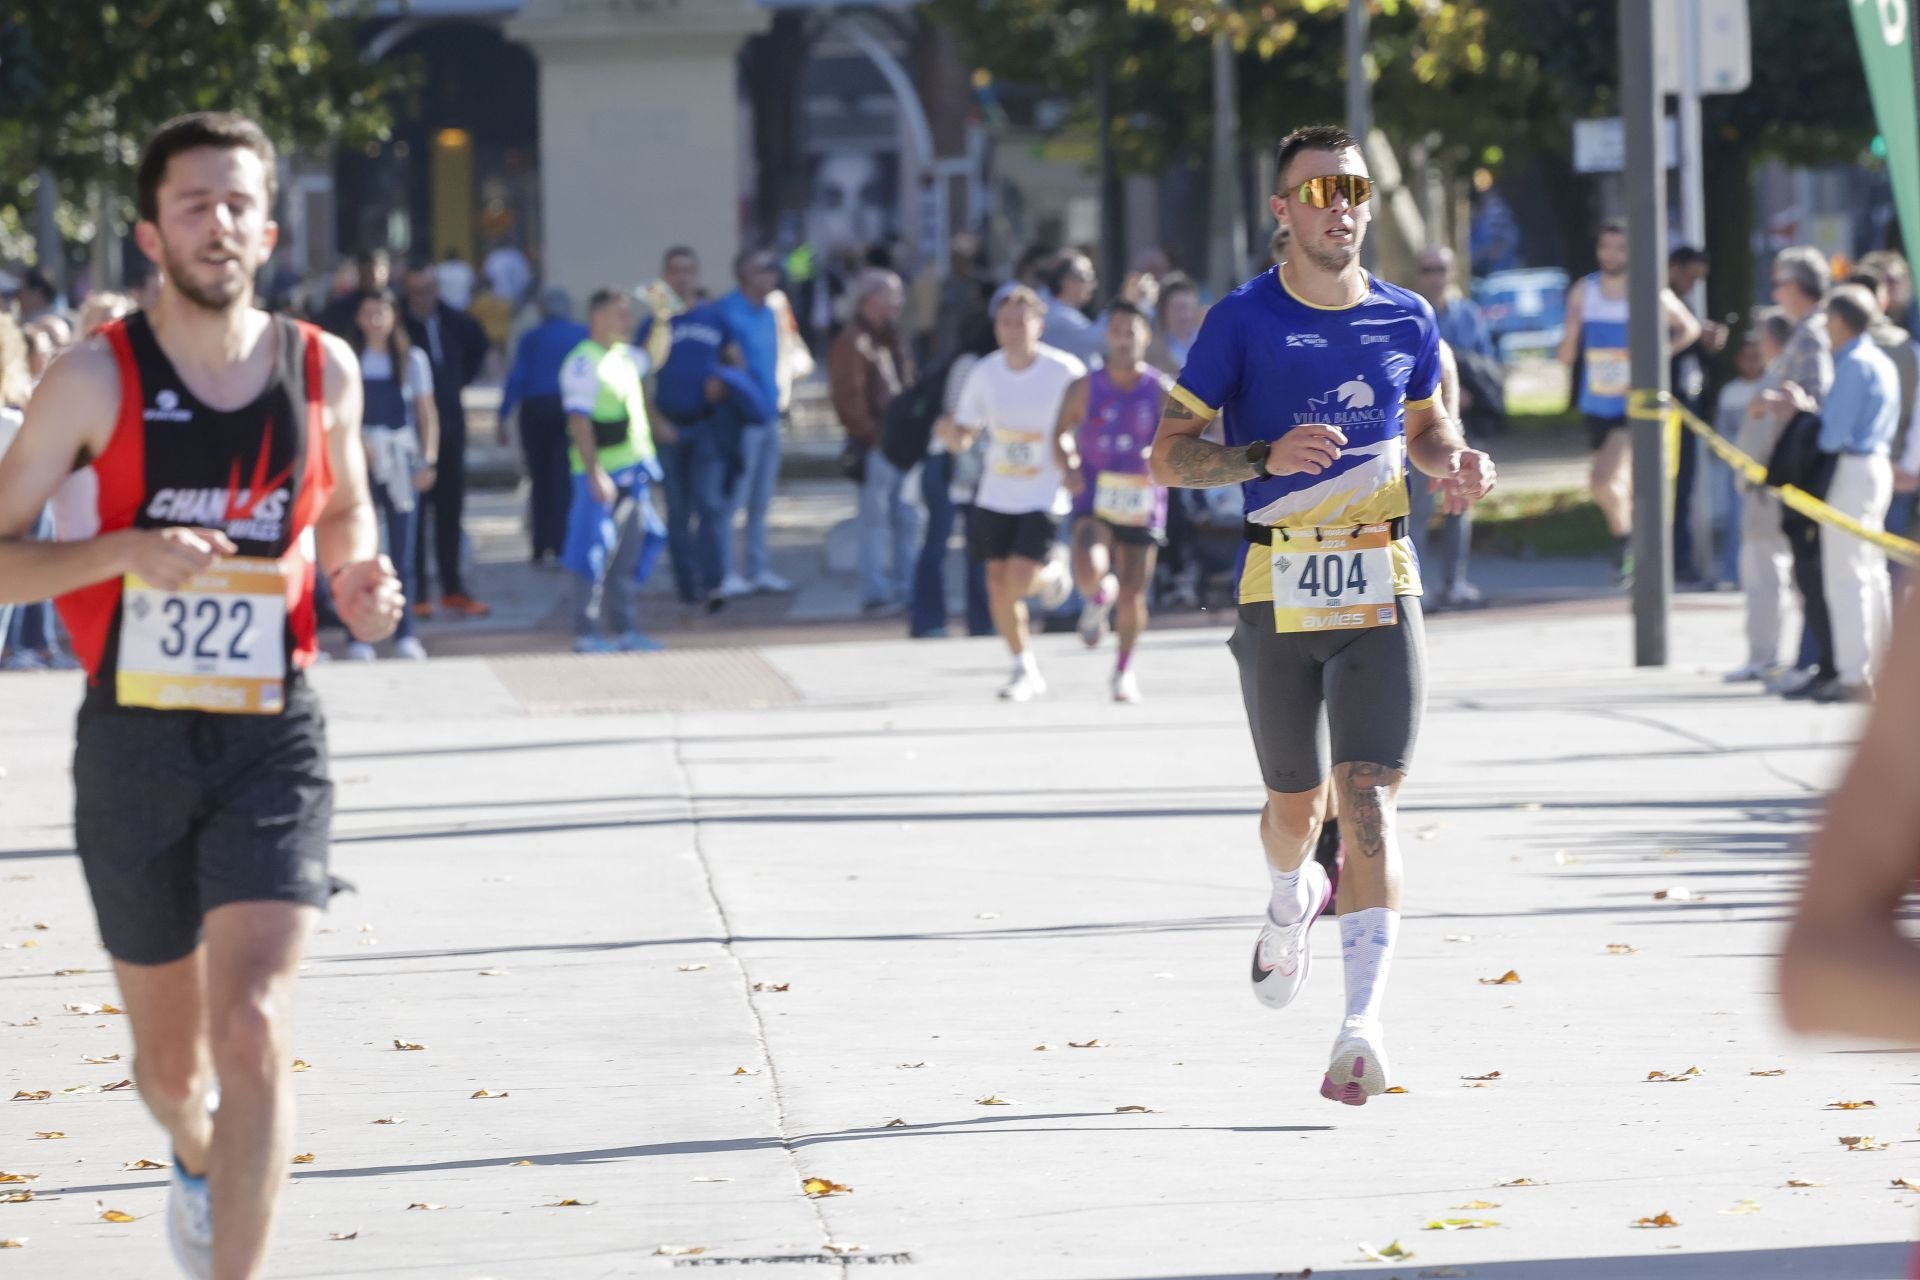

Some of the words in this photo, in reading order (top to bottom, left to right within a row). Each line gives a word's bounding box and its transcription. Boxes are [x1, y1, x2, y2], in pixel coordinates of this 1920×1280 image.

[1293, 412, 1331, 424] VILLA
[1334, 408, 1385, 423] BLANCA
[1298, 552, 1368, 597] 404
[160, 597, 254, 660] 322
[1303, 612, 1365, 628] aviles
